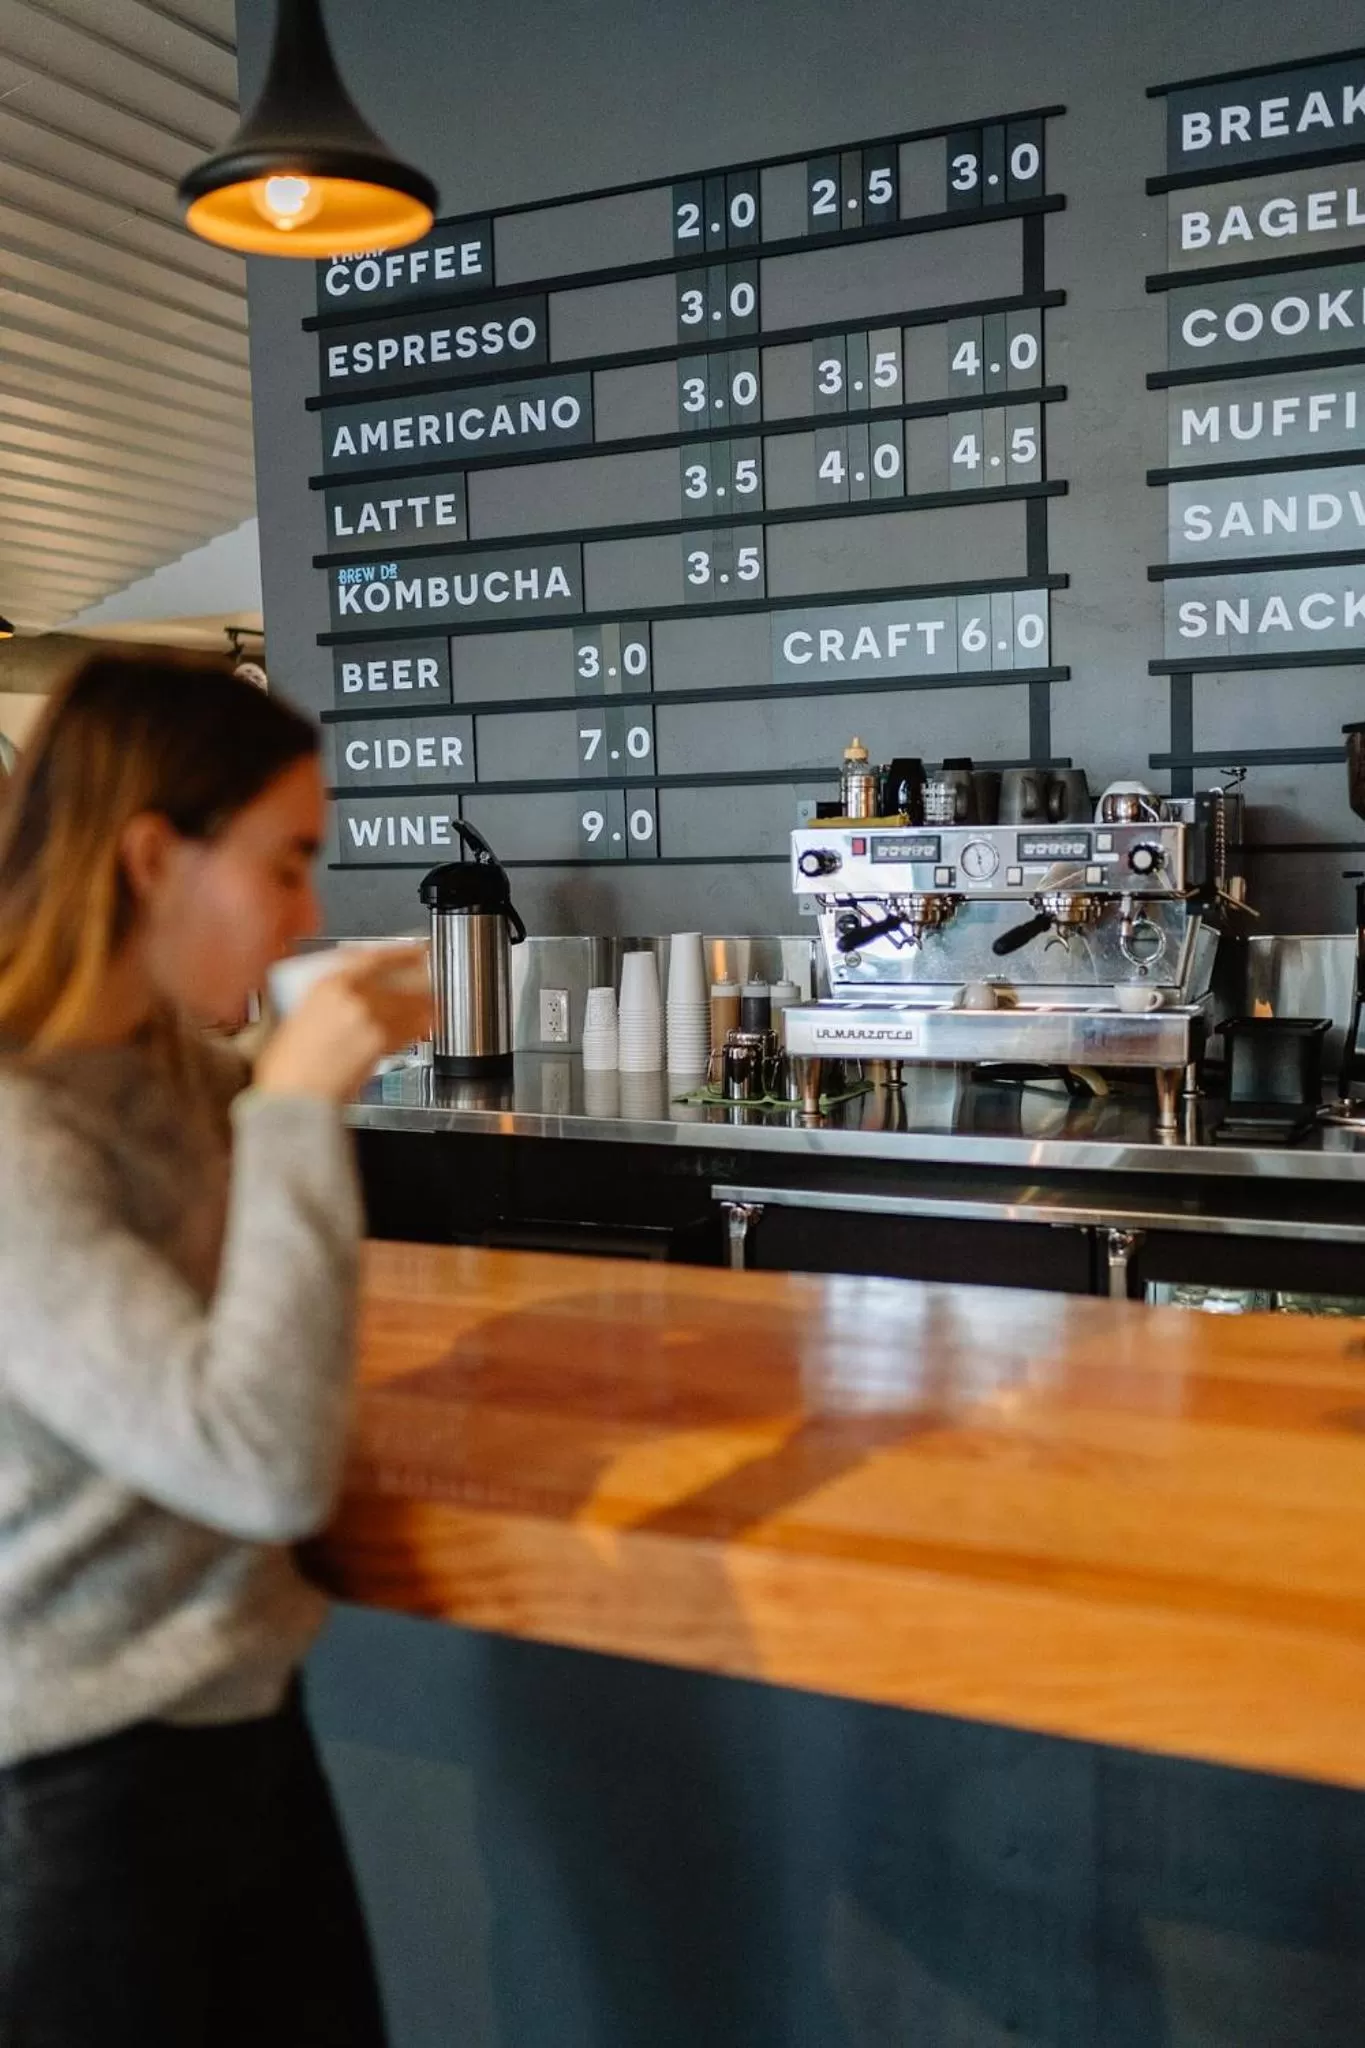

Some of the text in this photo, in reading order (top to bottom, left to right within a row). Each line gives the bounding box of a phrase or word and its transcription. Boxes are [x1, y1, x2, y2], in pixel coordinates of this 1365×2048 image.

[325, 143, 1040, 296] COFFEE 2.0 2.5 3.0
[328, 283, 755, 377] ESPRESSO 3.0
[1182, 287, 1365, 347] COOK
[332, 334, 1037, 457] AMERICANO 3.0 3.5 4.0
[1182, 392, 1356, 446] MUFFI
[334, 427, 1037, 536] LATTE 3.5 4.0 4.5
[338, 566, 375, 585] BREW
[338, 548, 760, 615] KOMBUCHA 3.5
[342, 614, 1045, 693] BEER 3.0 CRAFT 6.0
[345, 727, 651, 770] CIDER 7.0
[348, 810, 653, 847] WINE 9.0
